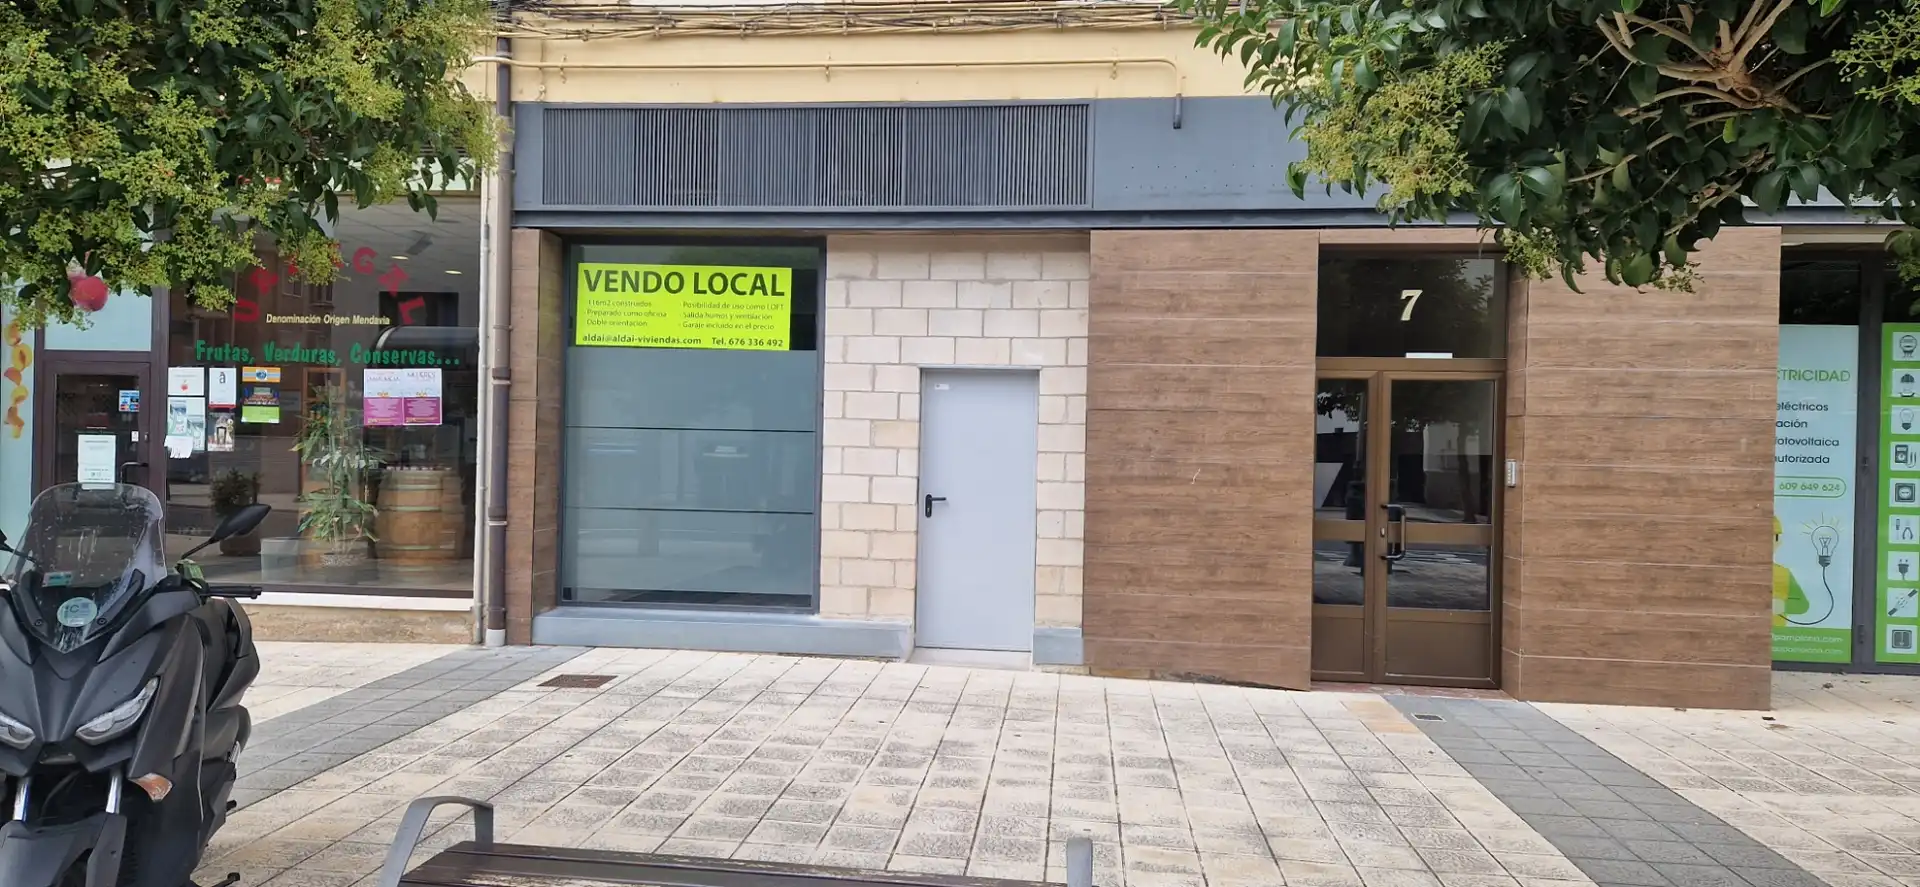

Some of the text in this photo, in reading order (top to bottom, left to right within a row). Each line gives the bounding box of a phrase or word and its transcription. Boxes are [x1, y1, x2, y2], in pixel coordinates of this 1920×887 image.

[583, 269, 785, 297] VENDO LOCAL
[683, 301, 720, 309] Posibilidad
[721, 301, 730, 309] de
[1400, 289, 1423, 321] 7
[266, 313, 390, 326] Denominación Origen Mendavia
[586, 309, 621, 318] Preparado
[644, 310, 667, 318] oficina
[683, 321, 704, 329] Garaje
[745, 322, 752, 330] el
[753, 323, 775, 331] precio
[583, 334, 784, 347] aldai@aldai-viviendas.com Tel. 676 336 492
[196, 339, 460, 366] Frutas, Verduras, Conservas...
[1779, 482, 1798, 491] 609
[1800, 483, 1819, 492] 649
